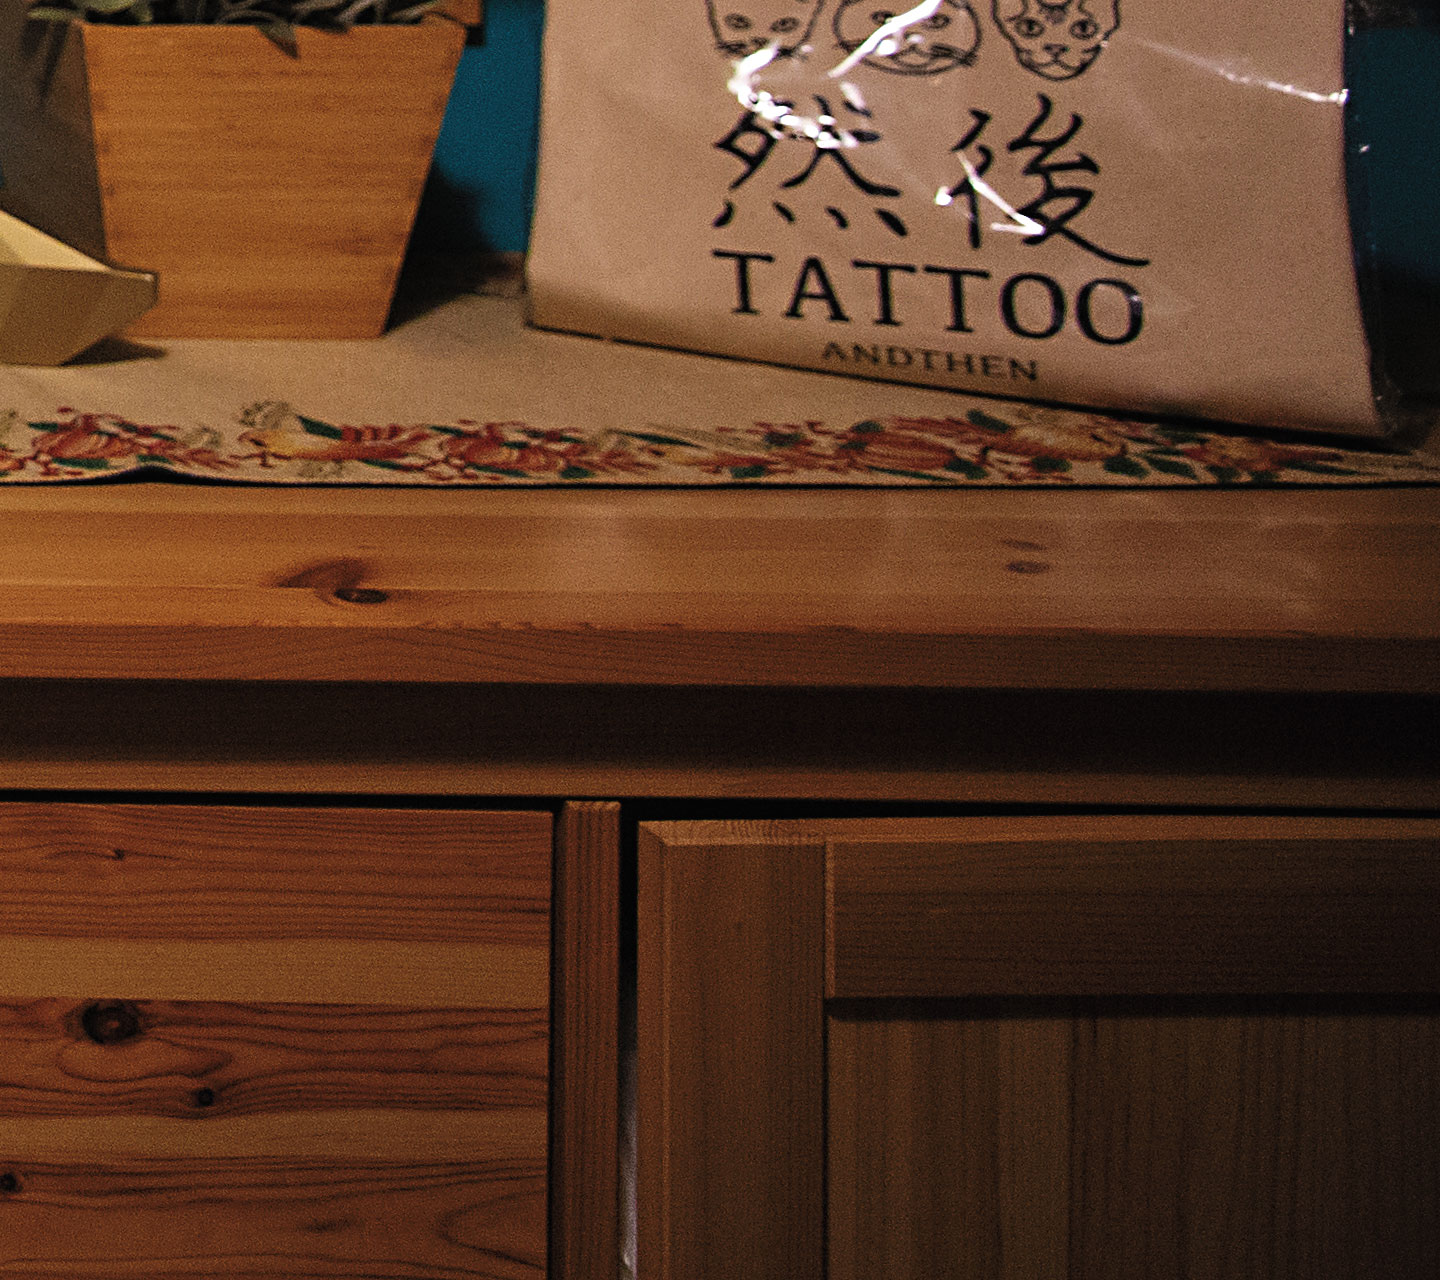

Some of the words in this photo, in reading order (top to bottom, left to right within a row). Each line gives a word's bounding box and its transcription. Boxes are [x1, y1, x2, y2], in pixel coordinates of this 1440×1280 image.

[712, 91, 1151, 268] 然後
[711, 249, 1146, 348] TATTOO
[821, 340, 1040, 383] ANDTHEN
